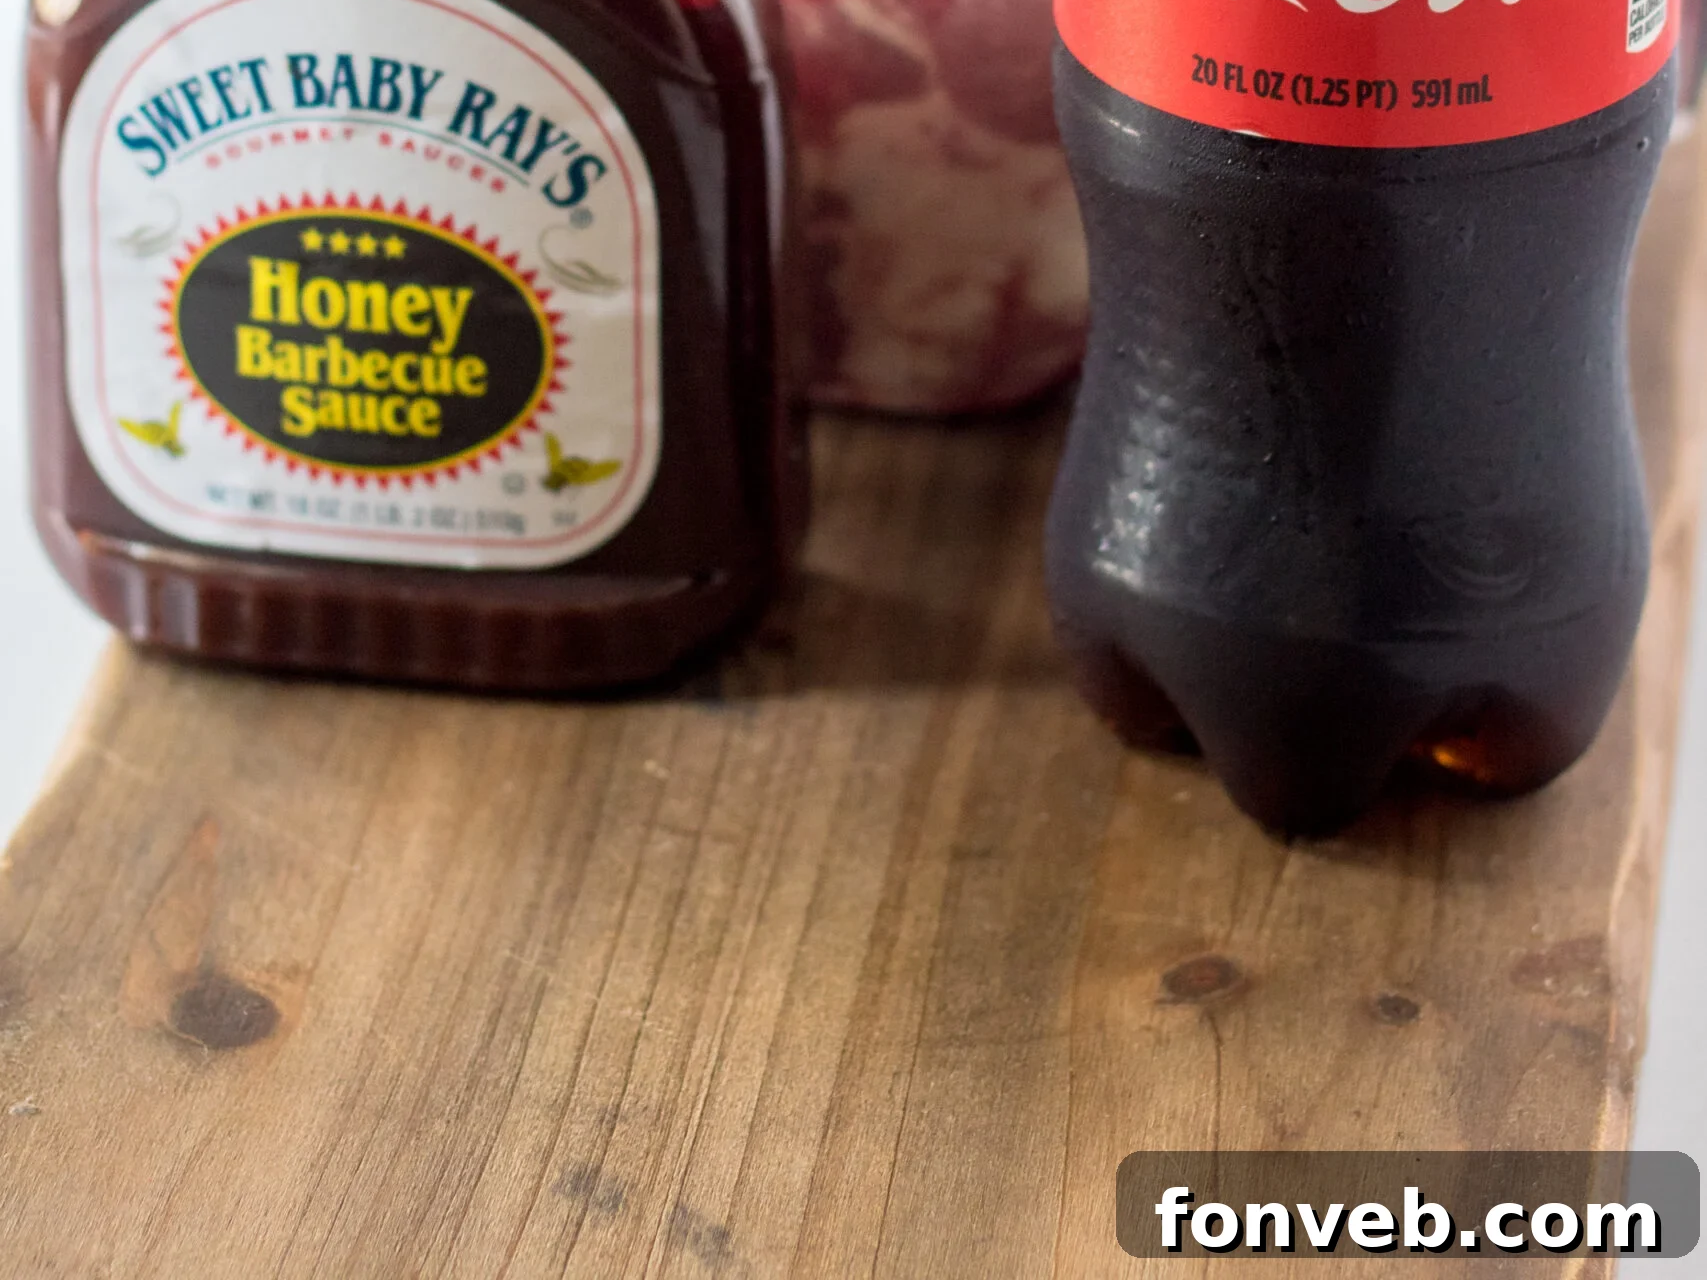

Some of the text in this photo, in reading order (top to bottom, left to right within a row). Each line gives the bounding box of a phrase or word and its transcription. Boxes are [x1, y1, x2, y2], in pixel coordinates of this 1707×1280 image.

[1191, 53, 1218, 87] 20
[1223, 61, 1248, 94] FL
[1253, 68, 1284, 101] OZ
[1291, 72, 1350, 107] (1.25
[1355, 78, 1398, 112] PT)
[1411, 77, 1452, 109] 591
[116, 53, 608, 208] SWEET BABY RAY'S
[247, 255, 474, 355] Honey
[234, 324, 488, 398] Barbecue
[281, 385, 442, 439] Sauce
